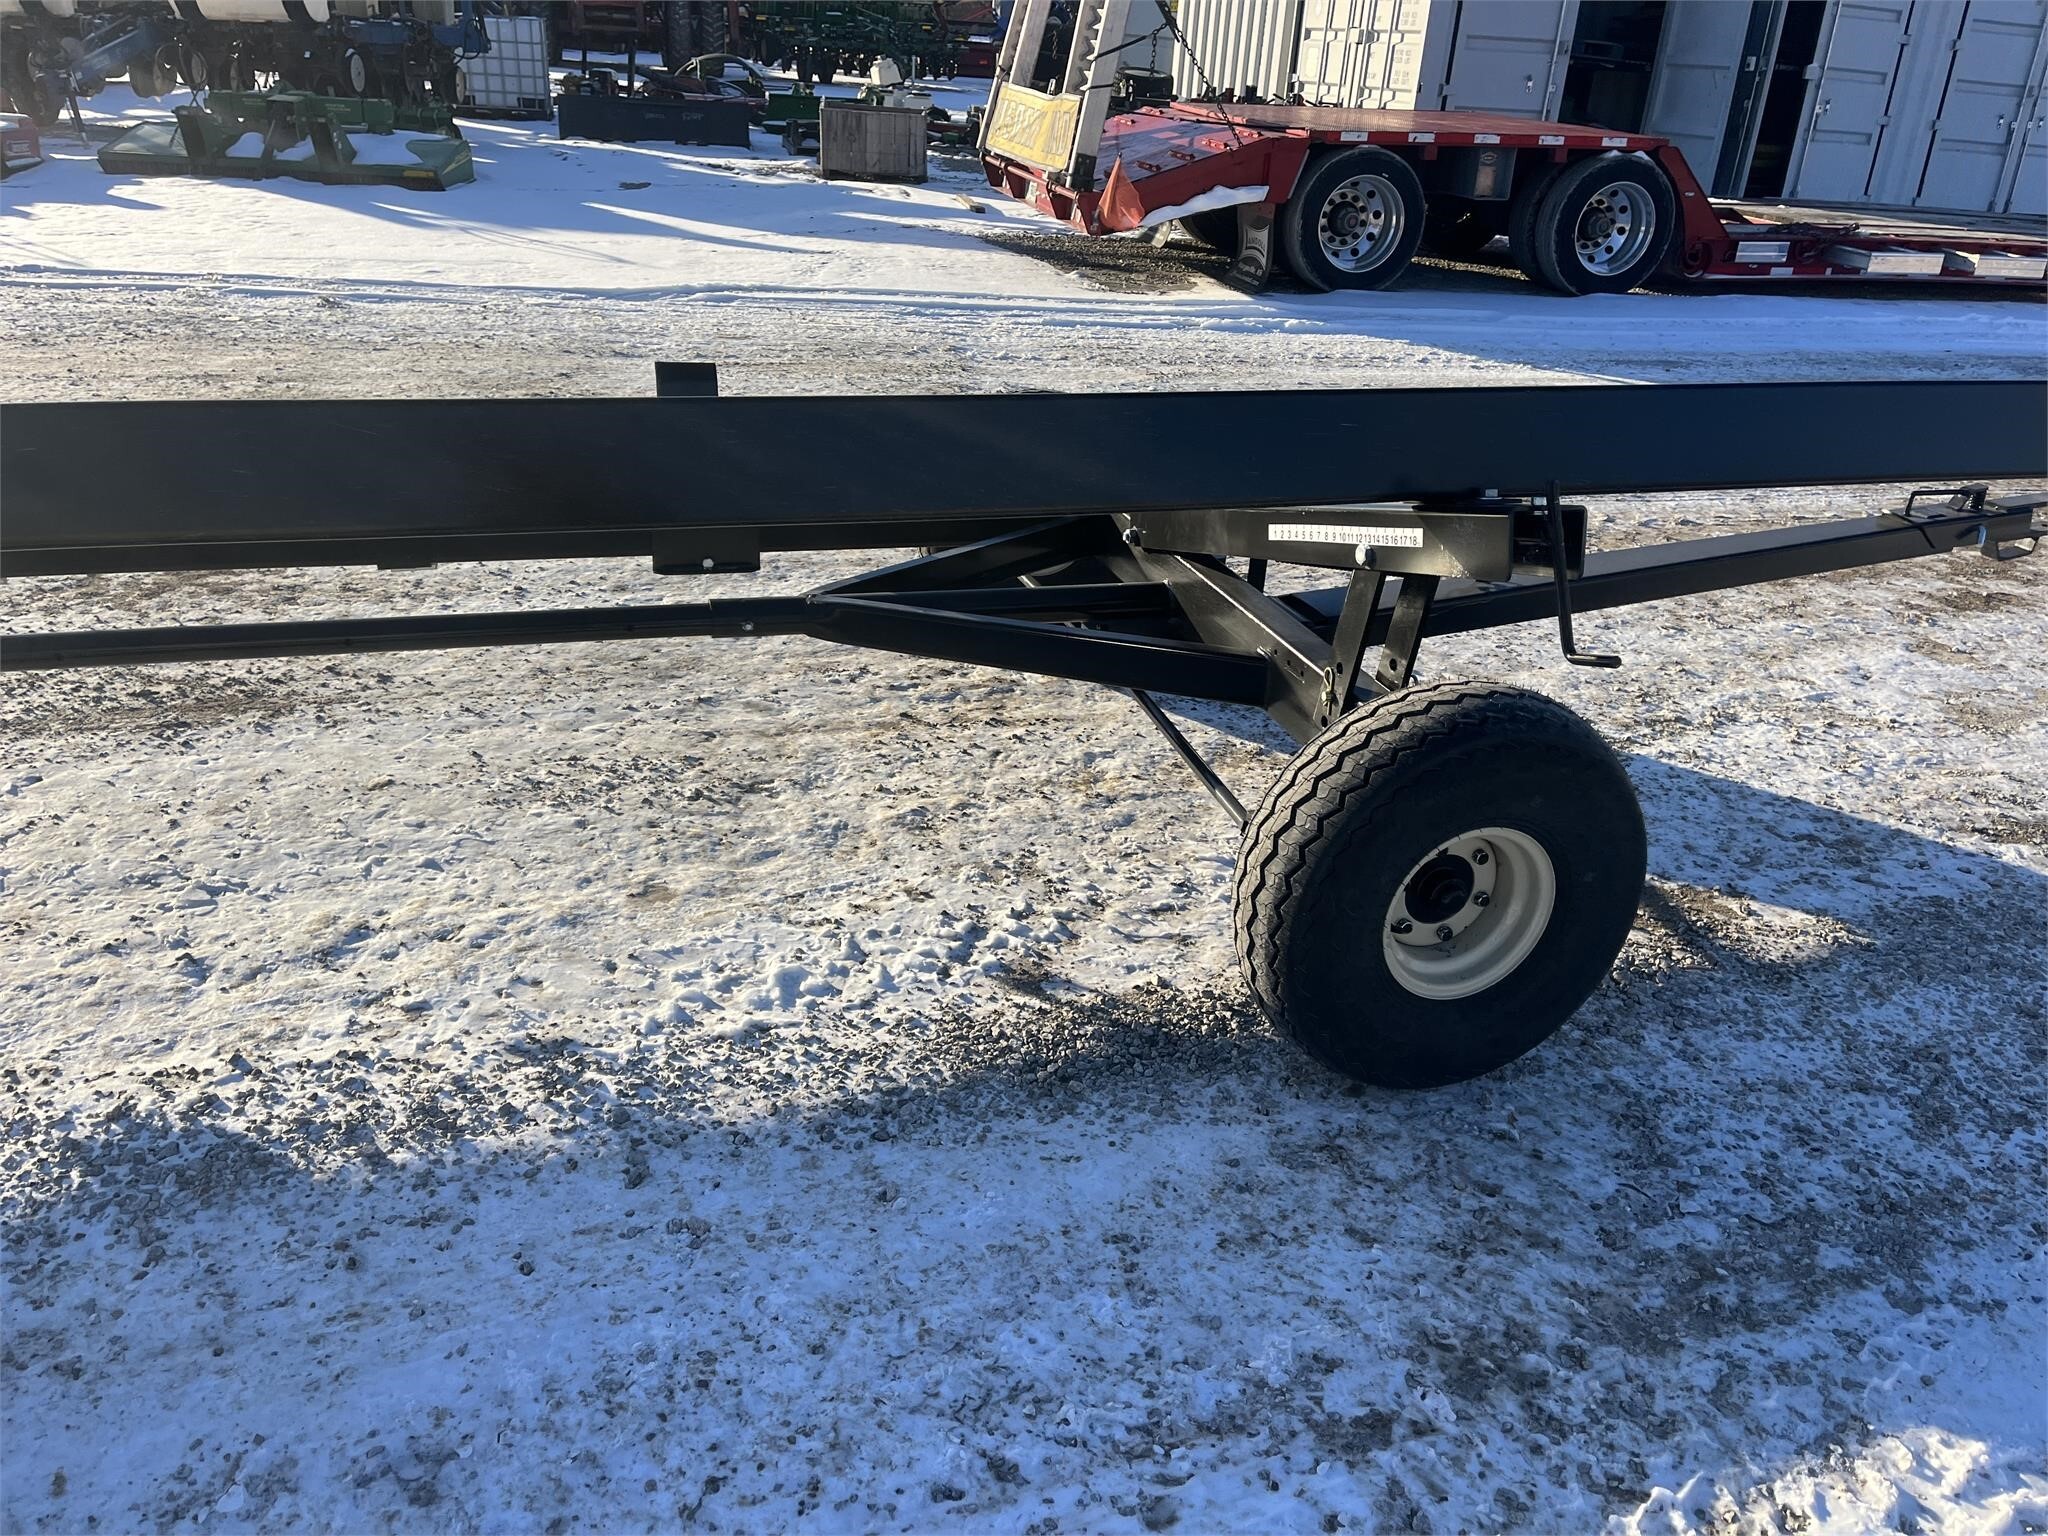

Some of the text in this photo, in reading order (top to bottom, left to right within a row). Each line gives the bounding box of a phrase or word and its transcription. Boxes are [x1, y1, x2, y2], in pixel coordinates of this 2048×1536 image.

[1339, 532, 1346, 542] 10
[1347, 532, 1354, 543] 11
[1355, 533, 1363, 543] 12
[1364, 533, 1371, 544] 13
[1372, 534, 1380, 544] 14
[1381, 534, 1389, 545] 15
[1390, 535, 1399, 545] 16
[1400, 535, 1408, 545] 17
[1409, 535, 1417, 545] 18
